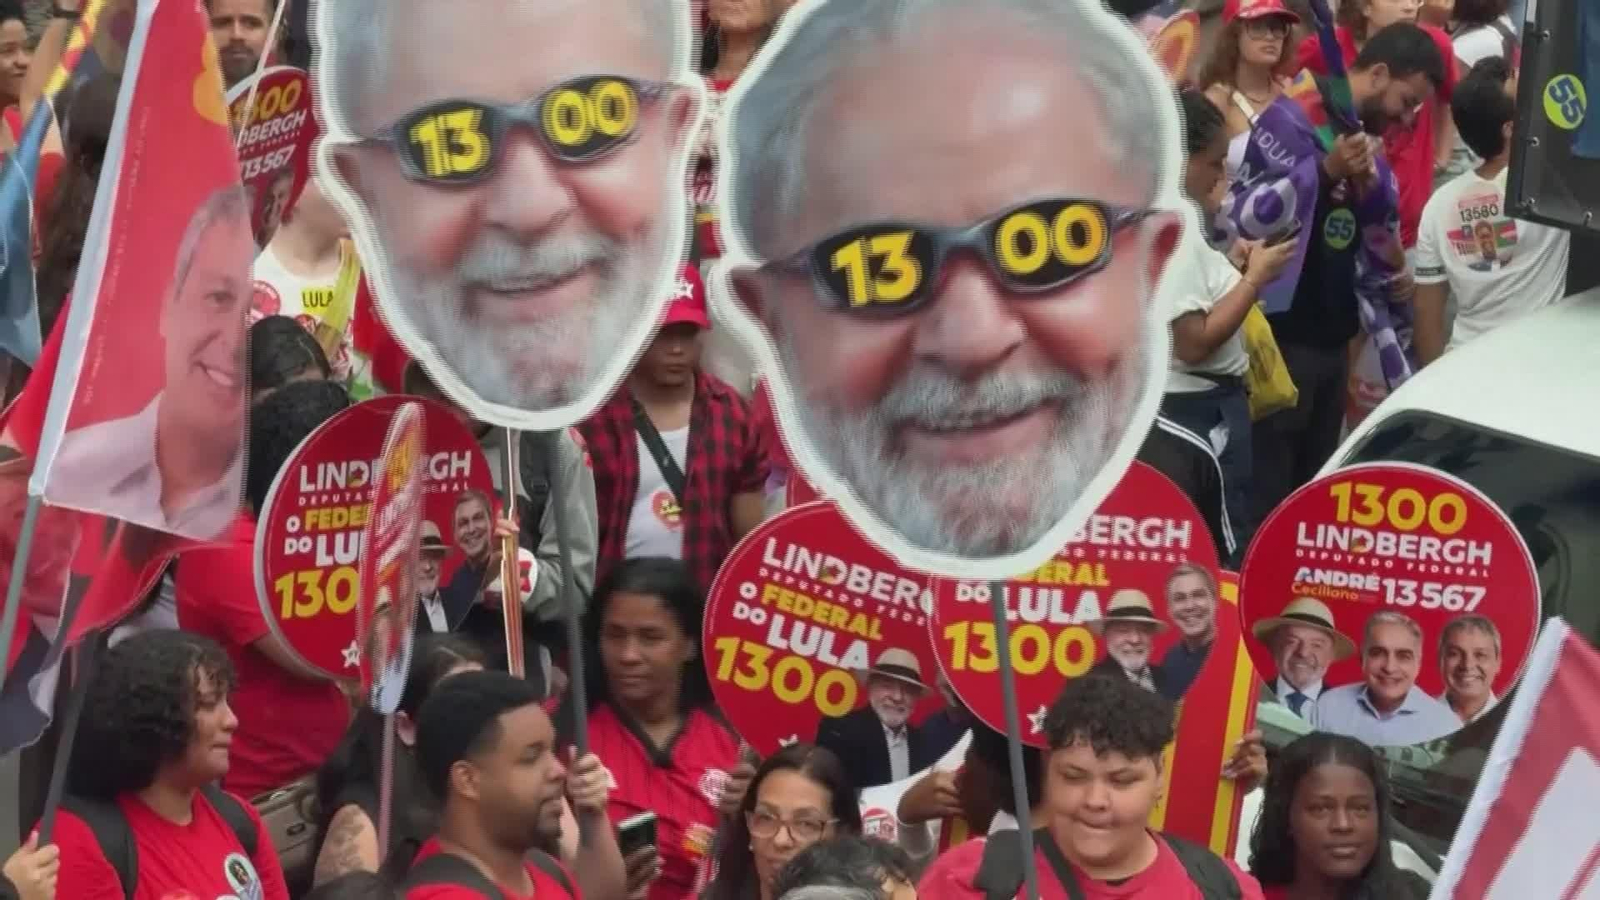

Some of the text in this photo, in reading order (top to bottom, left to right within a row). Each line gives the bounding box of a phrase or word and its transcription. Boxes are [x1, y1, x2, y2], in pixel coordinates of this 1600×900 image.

[1548, 76, 1584, 124] 55
[409, 79, 640, 177] 13 00
[244, 145, 296, 180] 13567
[831, 204, 1107, 306] 13 00
[286, 515, 300, 533] O
[1330, 480, 1468, 535] 1300
[284, 532, 361, 567] DO LU
[1296, 522, 1493, 566] LINDBERGH
[1296, 549, 1489, 578] DEPUTADO FEDERAL
[275, 566, 361, 619] 130
[955, 582, 1103, 625] DO LULA
[1294, 566, 1381, 592] ANDRÉ
[732, 601, 870, 670] DO LULA
[739, 581, 883, 640] O FEDERAL
[943, 620, 1096, 678] 1300
[714, 636, 858, 718] 1300
